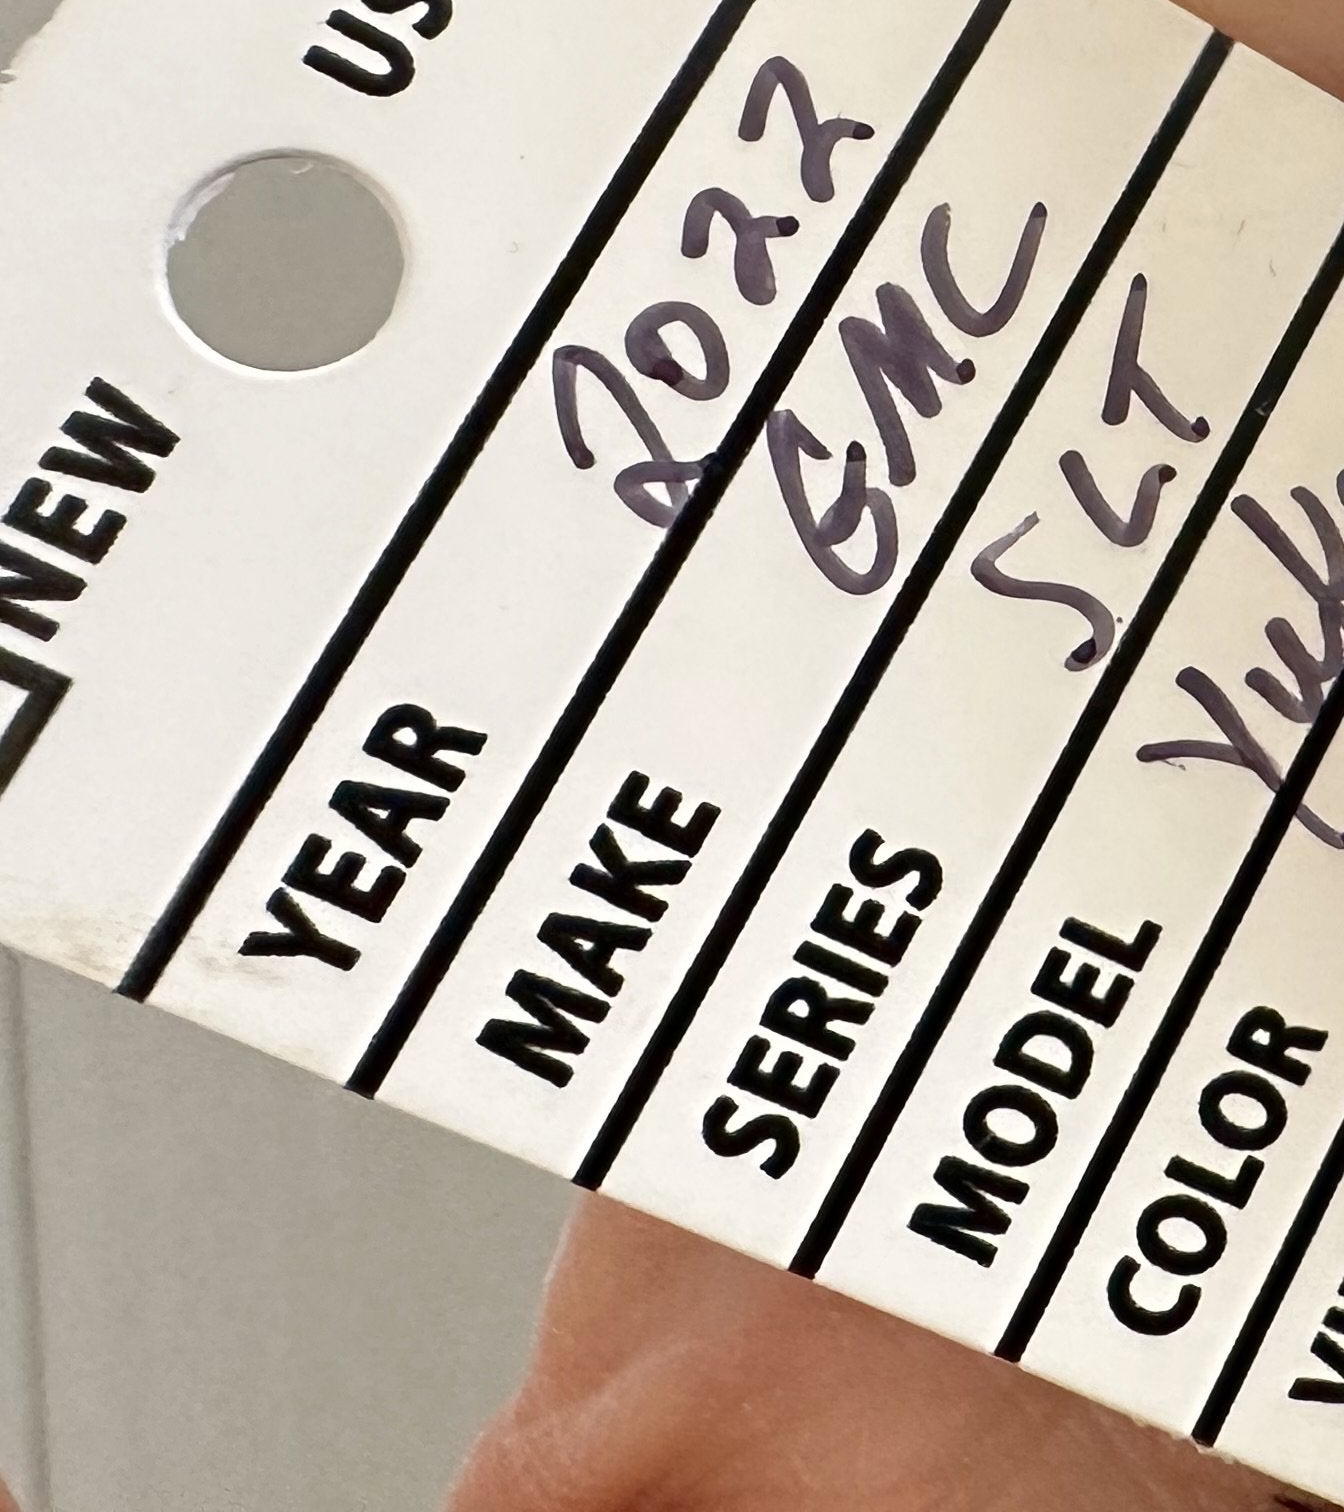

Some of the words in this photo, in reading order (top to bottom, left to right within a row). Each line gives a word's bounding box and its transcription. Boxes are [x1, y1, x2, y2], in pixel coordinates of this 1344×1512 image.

[553, 56, 875, 528] 2022
[767, 202, 1047, 595] GMC
[0, 376, 181, 642] NEW
[971, 273, 1210, 671] SLT
[238, 702, 488, 971] YEAR
[476, 771, 721, 1087] MAKE
[702, 829, 943, 1179] SERIES
[907, 917, 1162, 1267] MODEL
[1106, 1007, 1328, 1335] COLOR
